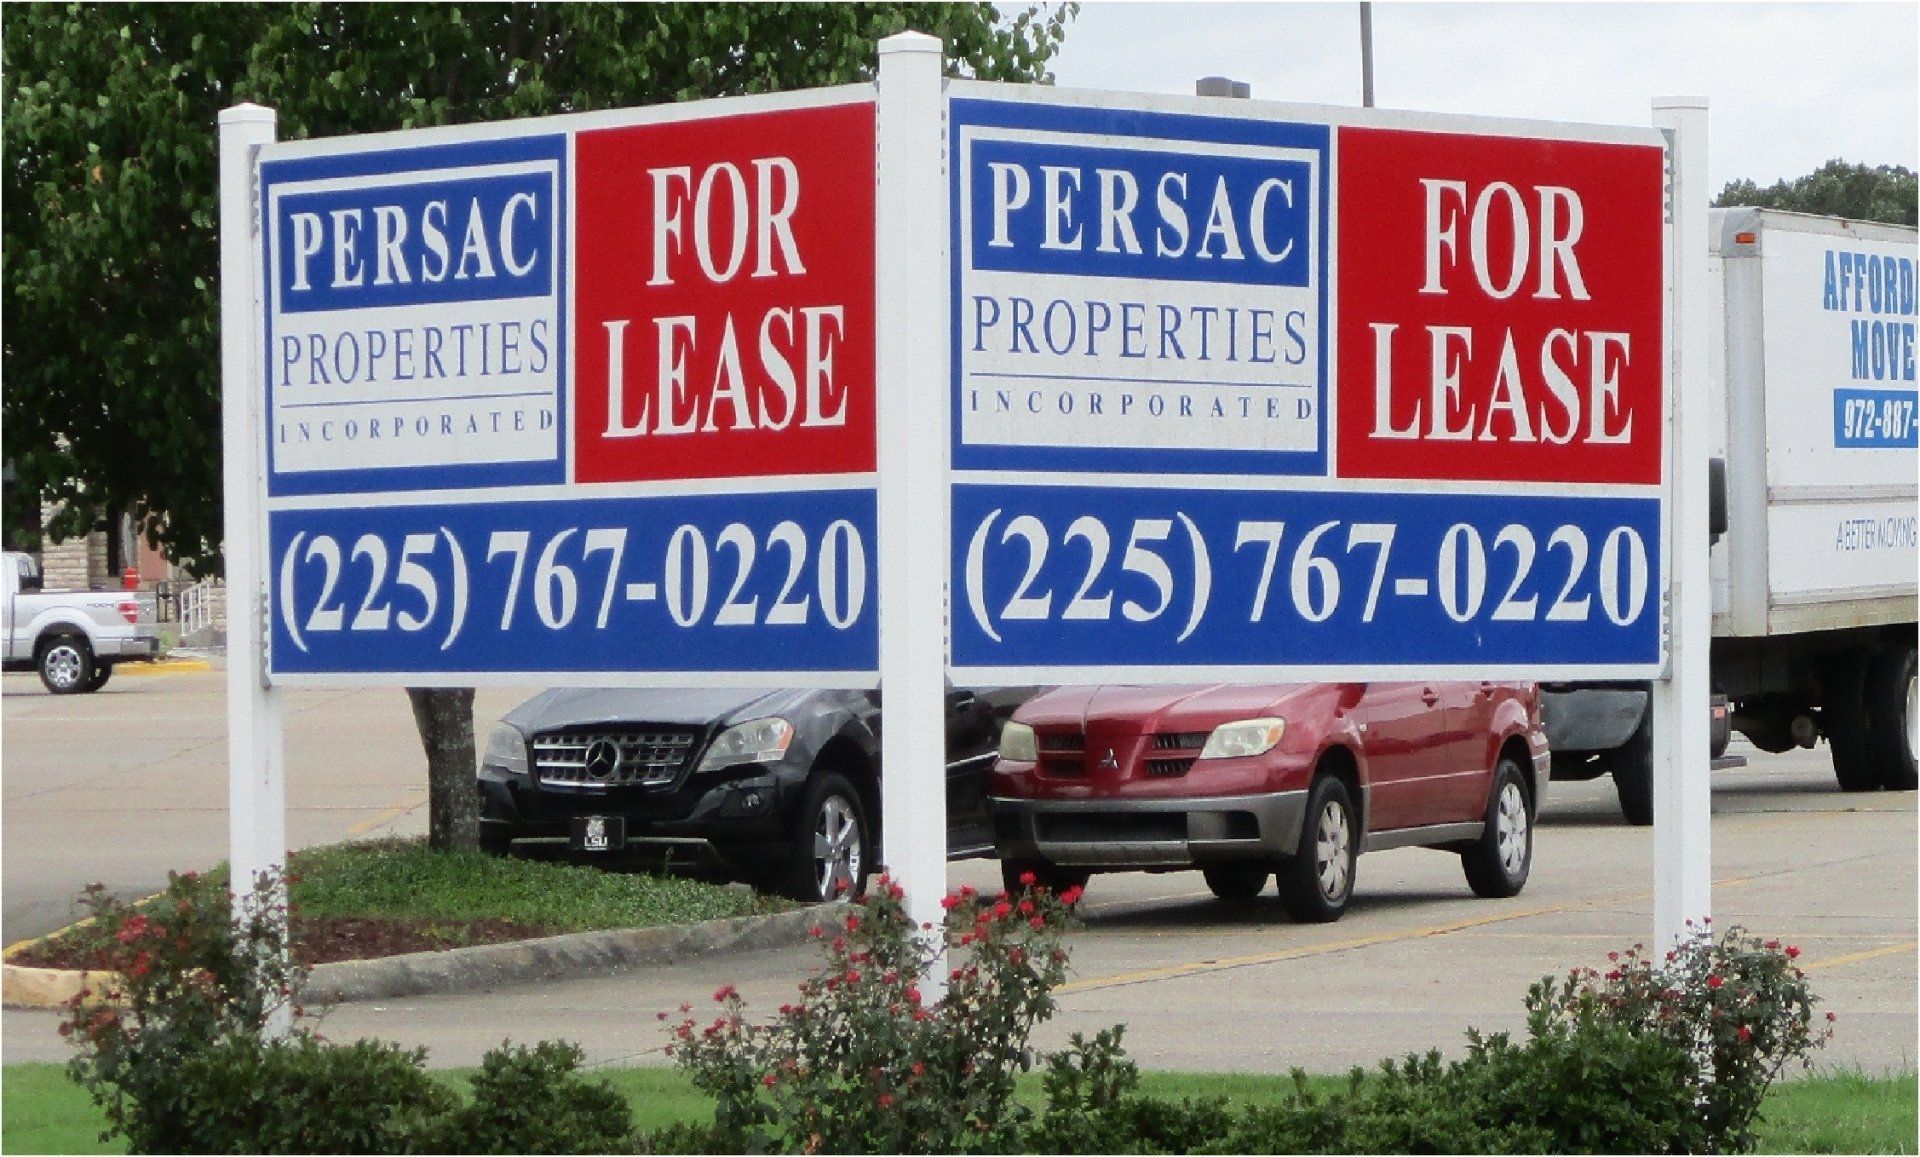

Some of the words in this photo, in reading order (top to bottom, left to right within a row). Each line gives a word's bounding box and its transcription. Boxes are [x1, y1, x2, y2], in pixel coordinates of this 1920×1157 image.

[290, 192, 537, 290] PERSAC
[646, 157, 806, 287] FOR
[988, 162, 1294, 263] PERSAC
[1419, 177, 1592, 301] FOR
[972, 295, 1308, 365] PROPERTIES
[1823, 250, 1918, 316] AFFORD
[280, 318, 549, 386] PROPERTIES
[601, 306, 848, 439] LEASE
[1368, 322, 1634, 445] LEASE
[280, 410, 554, 444] INCORPORATED
[970, 390, 1313, 420] INCORPORATED
[966, 508, 1212, 643] (225)
[1233, 519, 1649, 626] 767-0220
[1845, 519, 1876, 550] BETTER
[1878, 517, 1917, 549] MOVING
[279, 527, 469, 652] (225)
[486, 519, 867, 631] 767-0220
[584, 836, 608, 847] LSU
